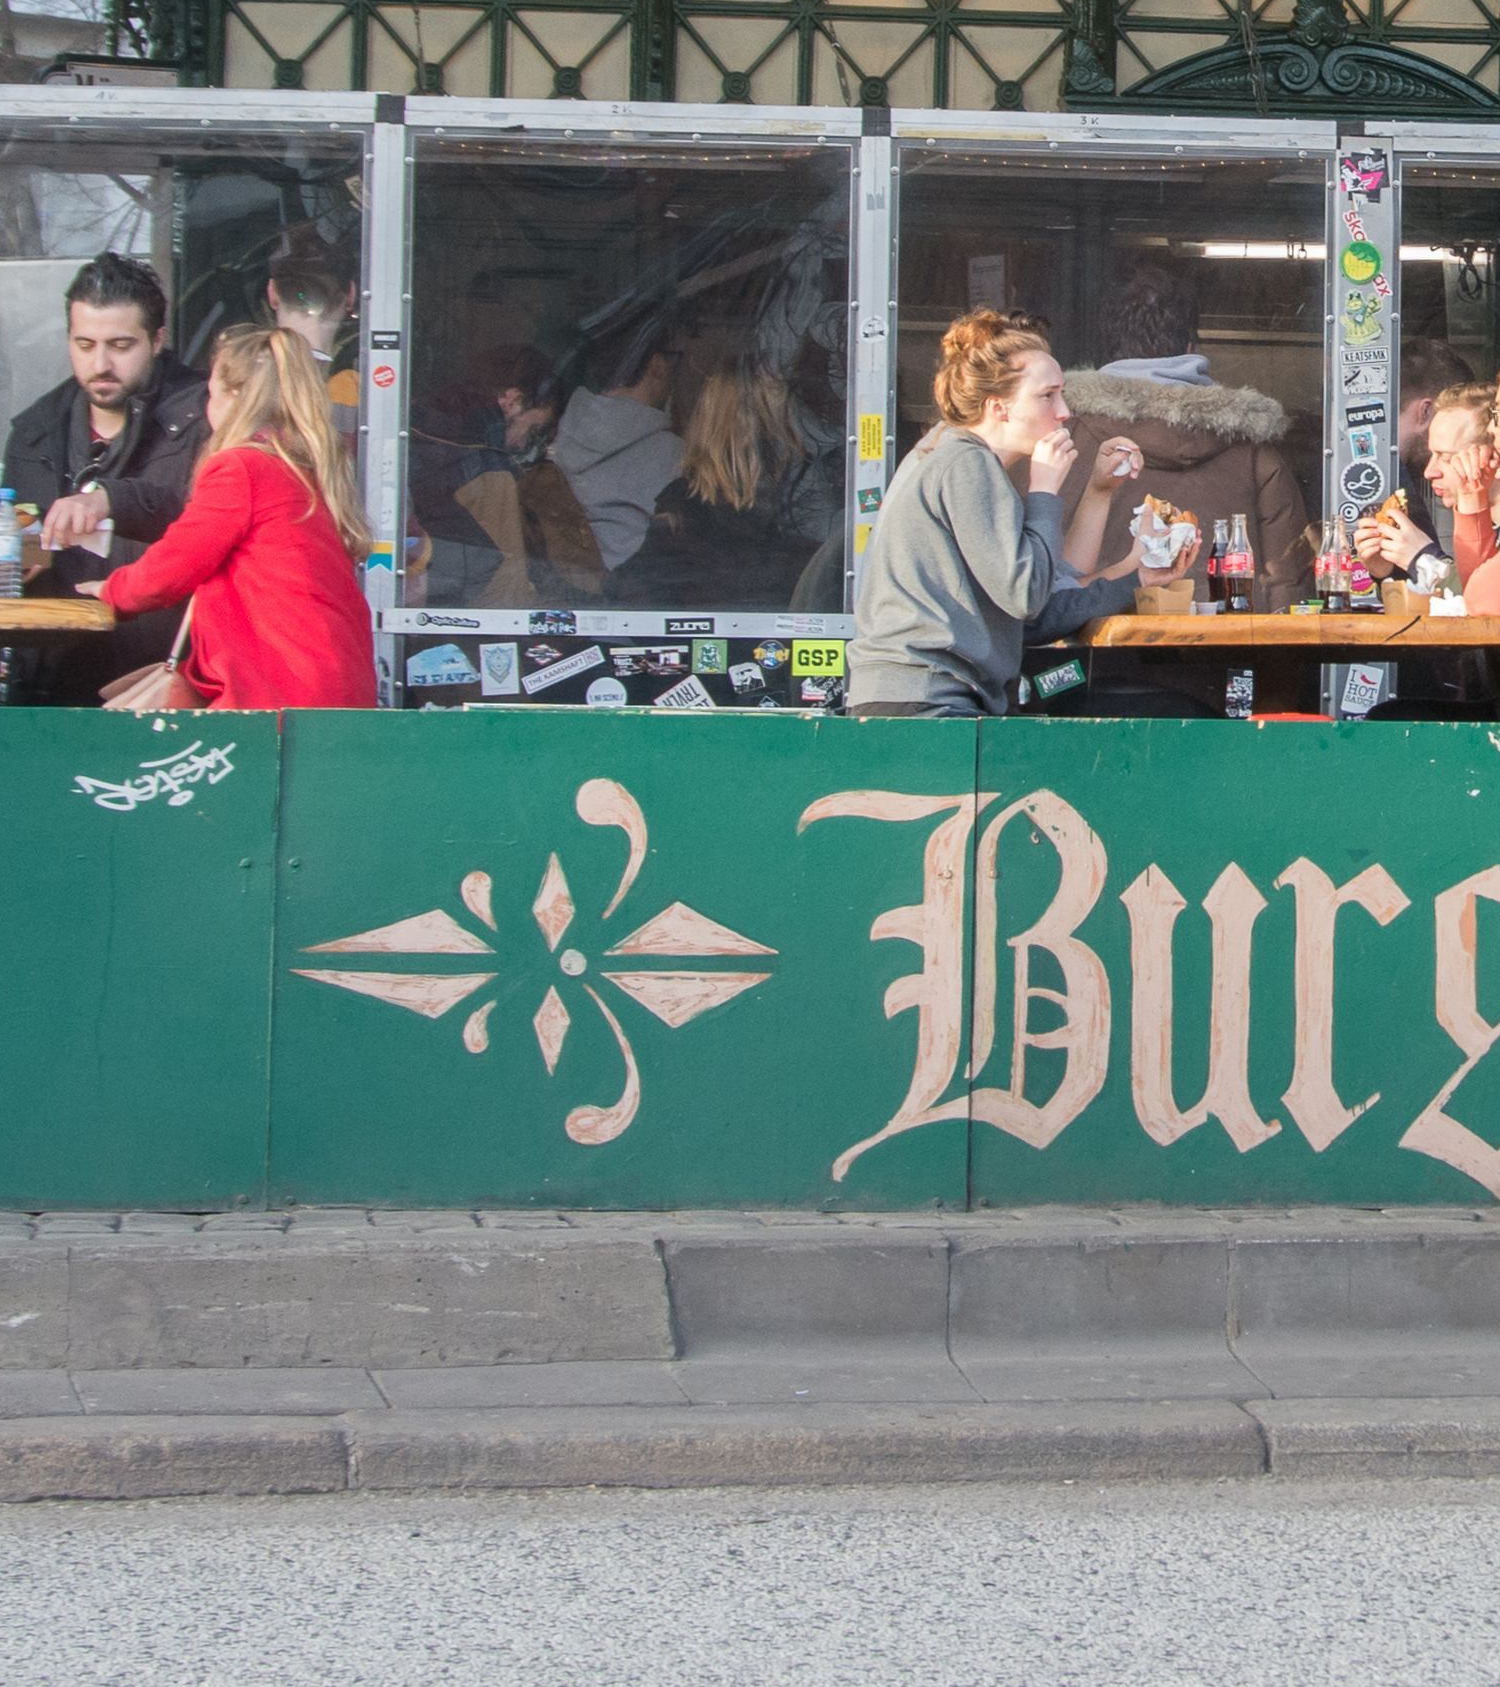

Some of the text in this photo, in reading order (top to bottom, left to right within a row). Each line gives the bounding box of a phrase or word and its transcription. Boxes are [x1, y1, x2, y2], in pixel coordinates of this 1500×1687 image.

[1348, 408, 1384, 421] europa
[797, 648, 840, 667] GSP
[1349, 669, 1357, 682] I
[1347, 683, 1378, 699] HOT
